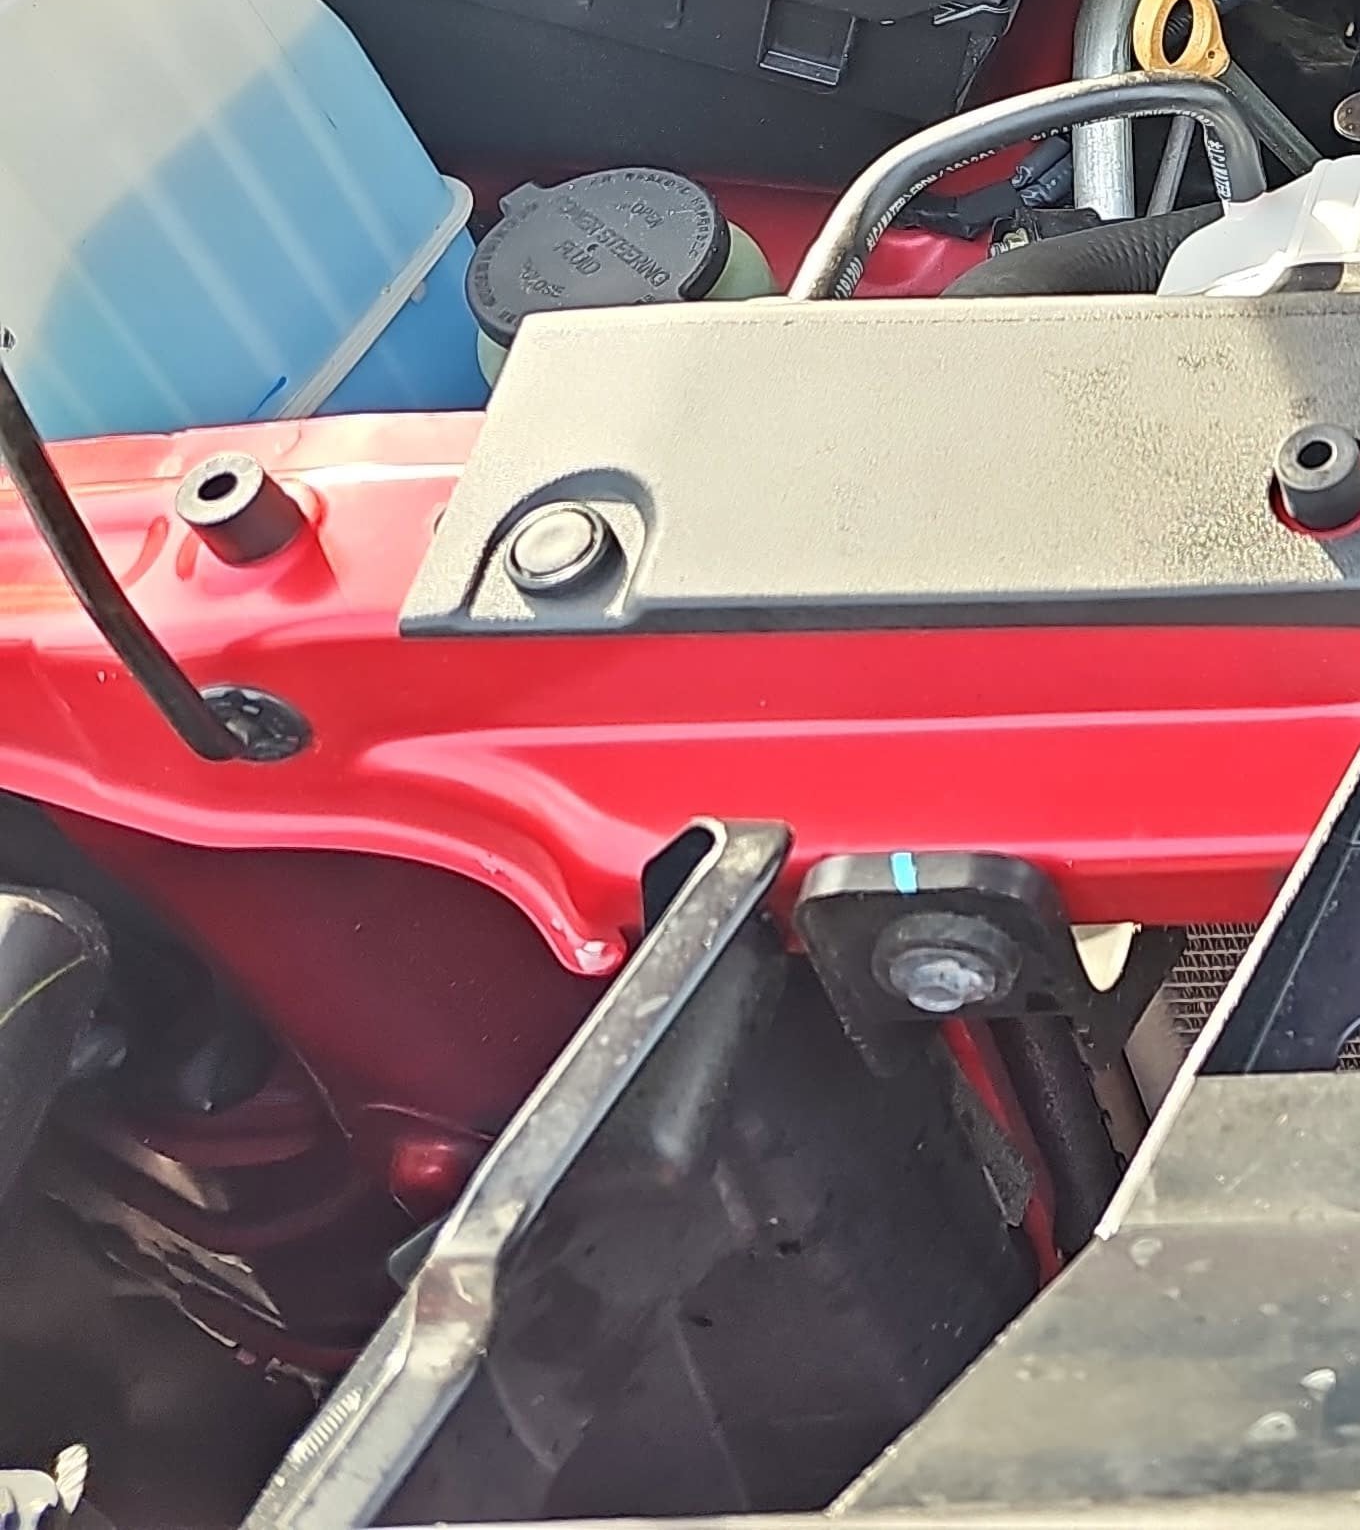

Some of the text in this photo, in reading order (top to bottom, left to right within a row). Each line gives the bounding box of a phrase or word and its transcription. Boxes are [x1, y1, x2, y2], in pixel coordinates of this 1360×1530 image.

[629, 200, 665, 230] OPEN
[553, 238, 602, 277] FLUID
[596, 226, 672, 288] STEERING
